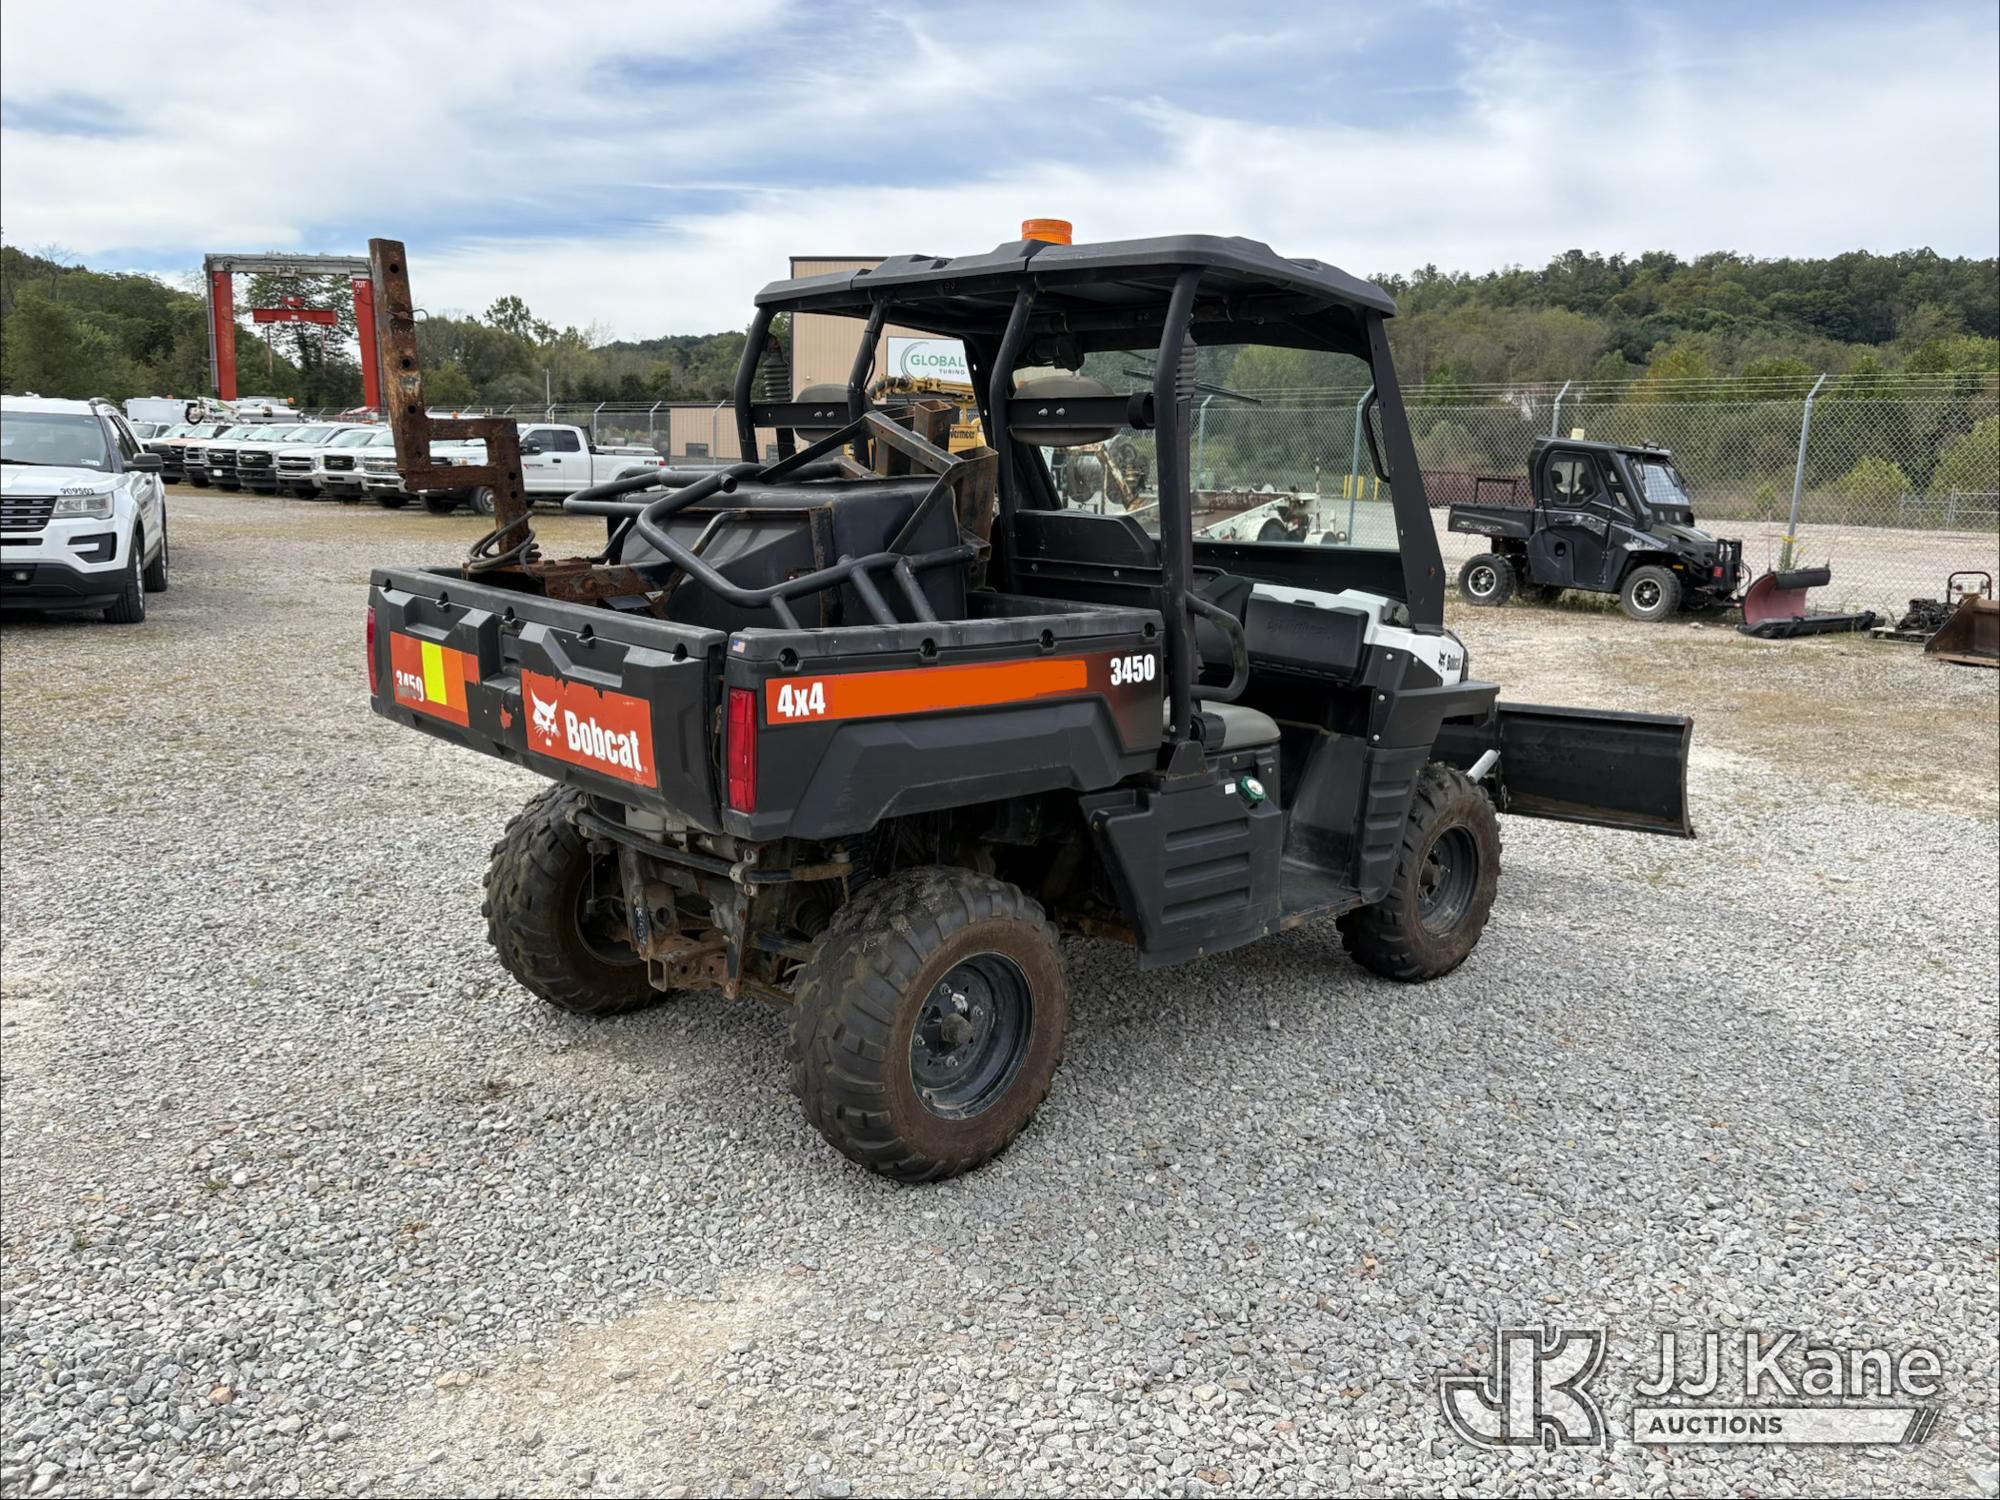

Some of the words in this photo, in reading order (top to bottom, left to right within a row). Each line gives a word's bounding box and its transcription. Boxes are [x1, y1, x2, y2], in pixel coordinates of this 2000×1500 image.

[911, 354, 965, 368] GLOBAL
[1110, 653, 1156, 686] 3450
[777, 681, 827, 718] 4x4
[564, 708, 643, 773] Bobcat
